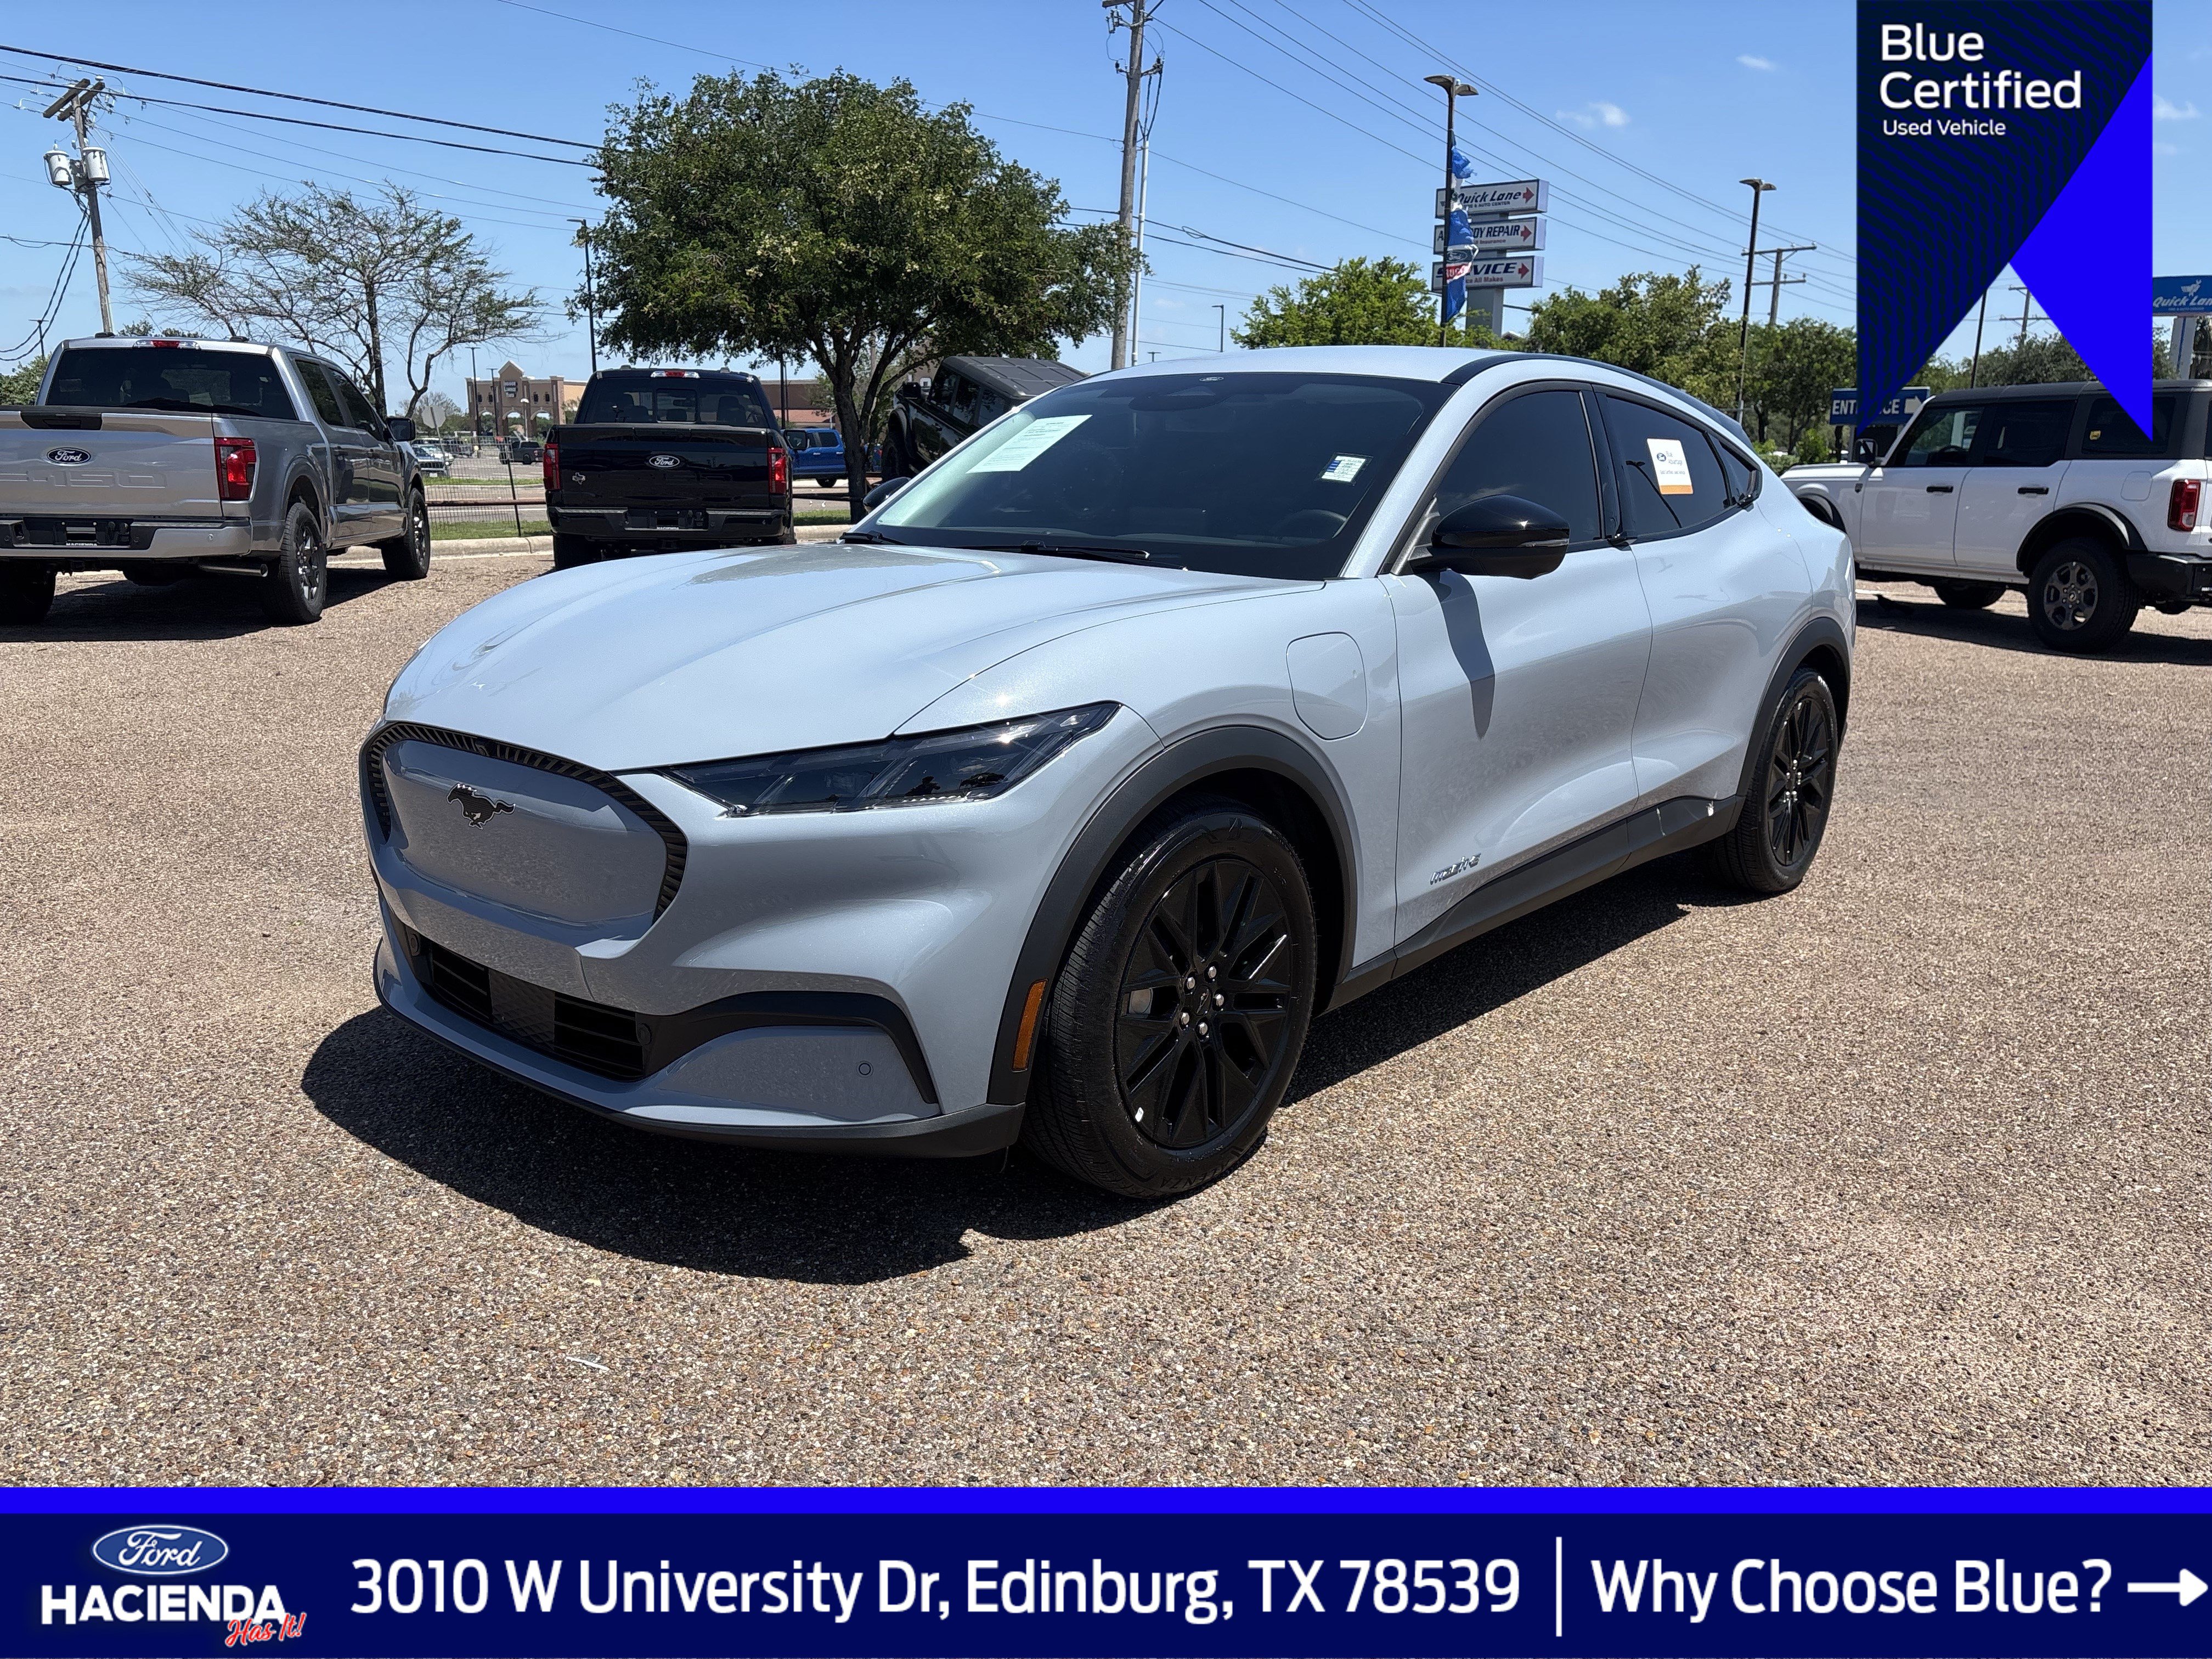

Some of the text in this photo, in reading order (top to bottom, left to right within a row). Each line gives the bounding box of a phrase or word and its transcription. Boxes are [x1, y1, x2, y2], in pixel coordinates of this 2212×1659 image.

[1489, 190, 1522, 202] Lane
[1486, 225, 1520, 238] REPAIR
[2153, 295, 2212, 308] Quick Lan
[1832, 399, 1900, 415] ENTCE
[55, 450, 82, 461] Ford
[654, 457, 674, 465] Ford
